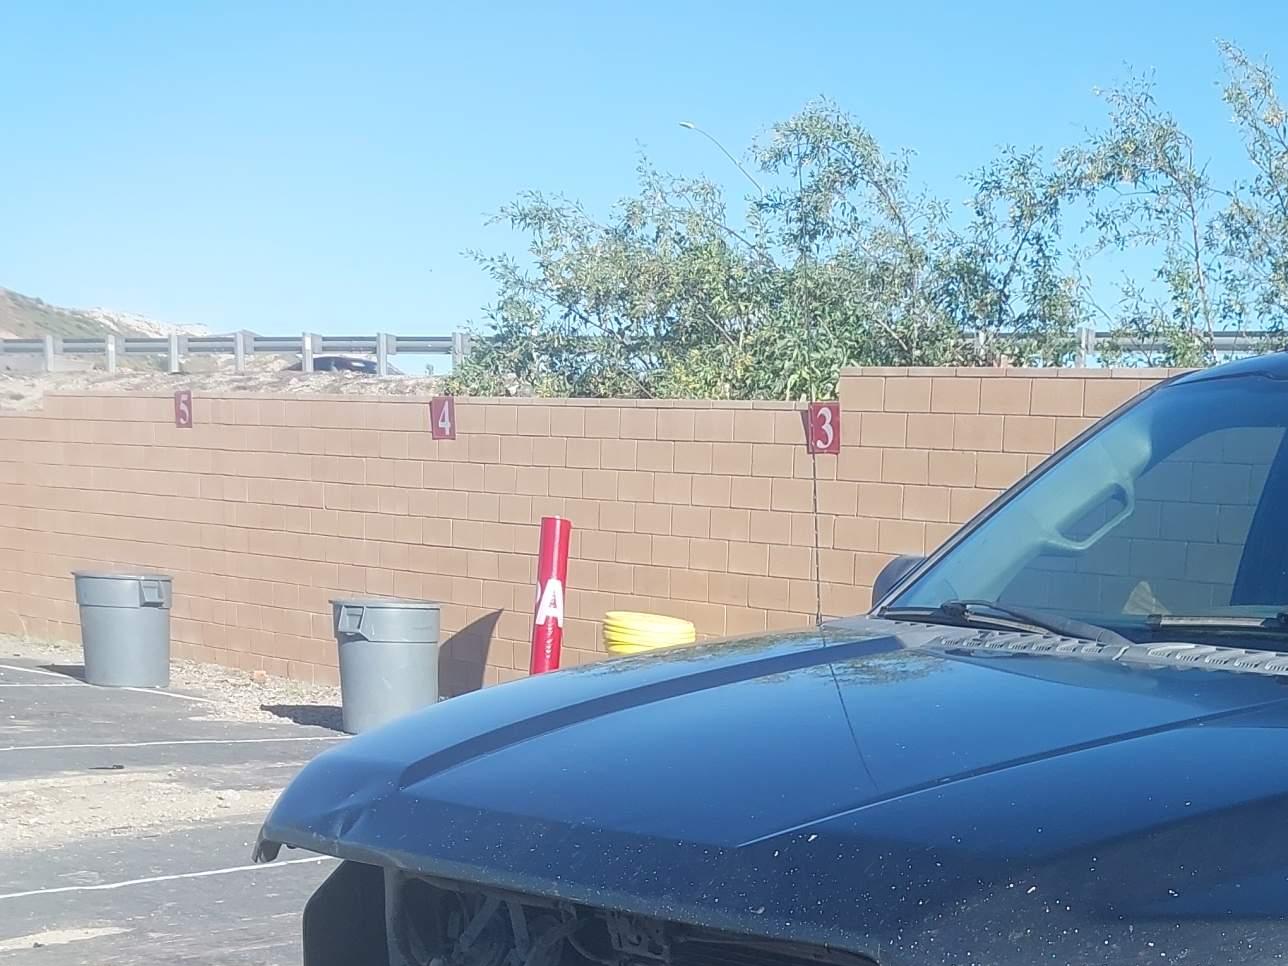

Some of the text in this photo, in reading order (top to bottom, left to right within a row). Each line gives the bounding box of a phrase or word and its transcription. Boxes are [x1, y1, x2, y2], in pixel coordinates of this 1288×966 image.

[180, 394, 189, 424] 5
[438, 400, 451, 436] 4
[816, 406, 834, 449] 3
